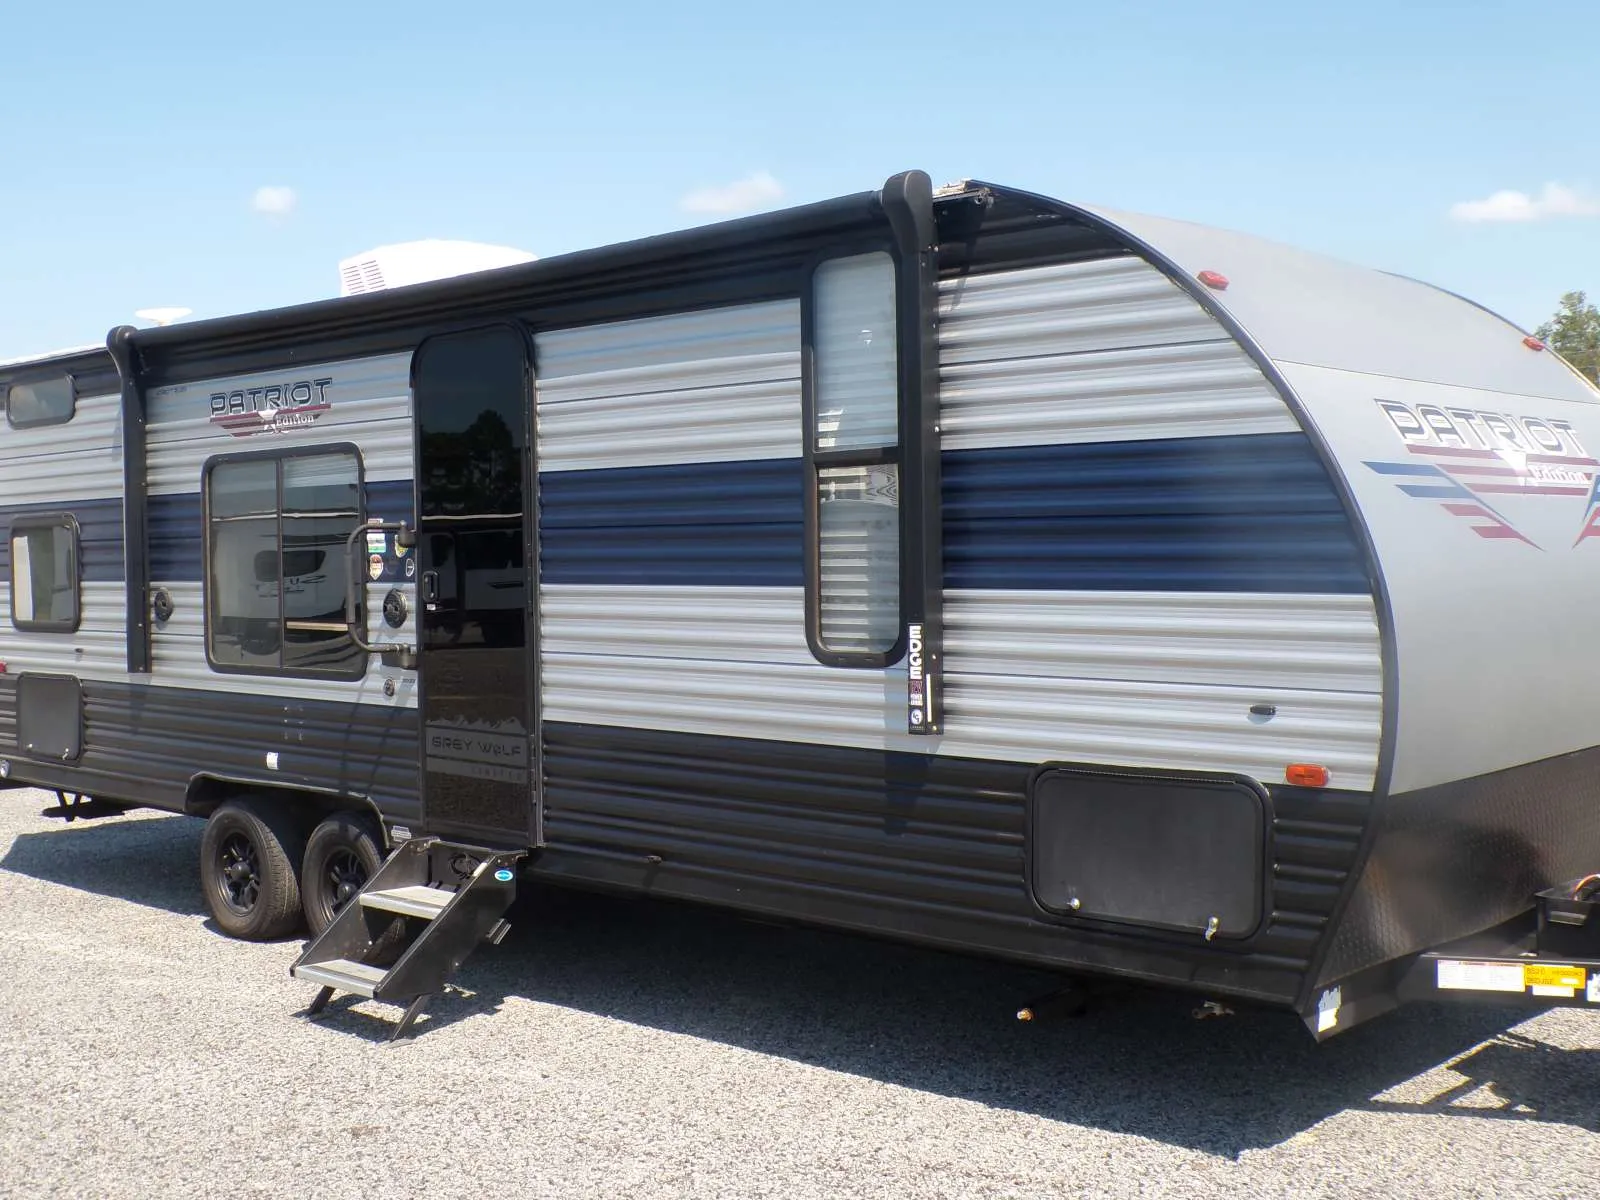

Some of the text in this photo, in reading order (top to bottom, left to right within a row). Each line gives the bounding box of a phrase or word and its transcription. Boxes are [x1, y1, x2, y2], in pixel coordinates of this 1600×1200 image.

[210, 378, 332, 415] PATRIOT
[276, 413, 315, 427] Edition
[1373, 398, 1590, 457] PATRIOT
[1530, 465, 1588, 484] Edition
[909, 625, 922, 680] EDGE
[432, 736, 473, 750] GREY
